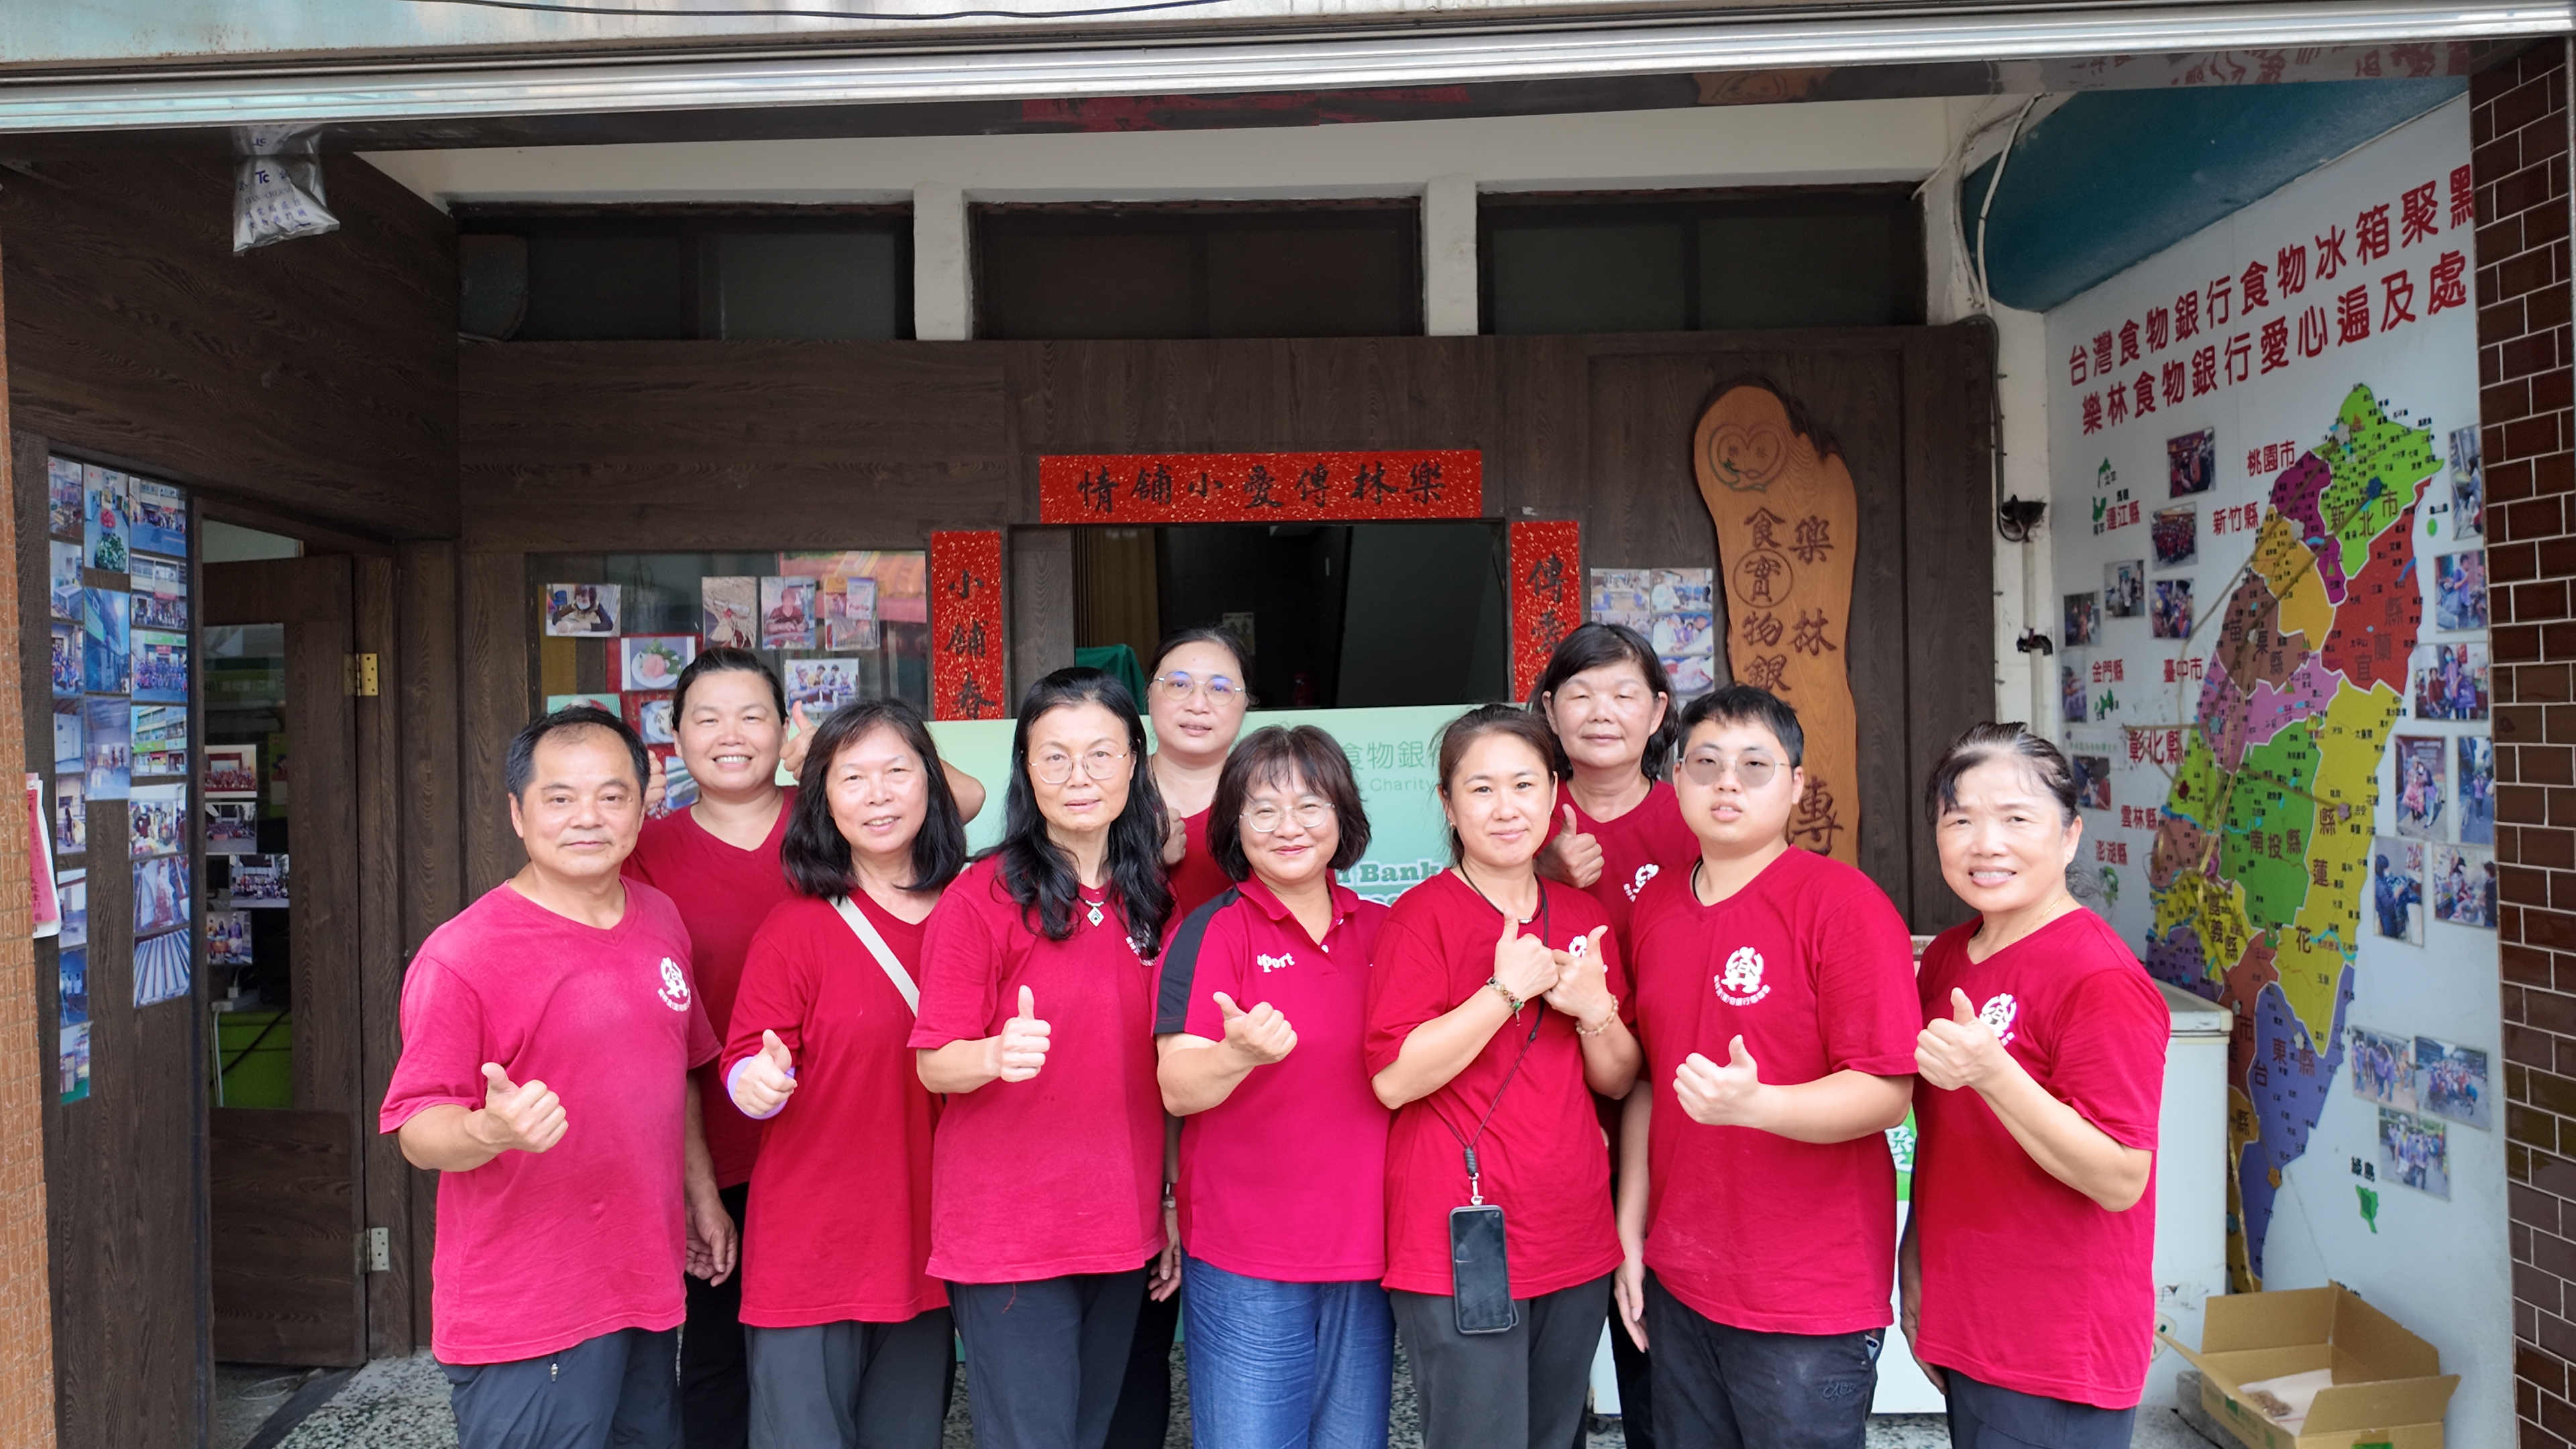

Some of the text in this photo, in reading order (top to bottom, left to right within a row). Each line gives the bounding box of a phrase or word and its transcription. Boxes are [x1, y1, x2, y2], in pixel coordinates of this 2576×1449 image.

[2247, 440, 2295, 478] 桃園市
[2106, 500, 2140, 531] 連江縣
[2212, 501, 2259, 535] 新竹縣
[2092, 659, 2125, 683] 金門縣
[2163, 657, 2202, 684] 臺中市
[2129, 729, 2185, 765] 彰化縣
[1370, 776, 1435, 793] Charity
[2121, 804, 2158, 831] 雲林縣
[2250, 828, 2302, 860] 南投縣
[1359, 861, 1440, 883] Bank
